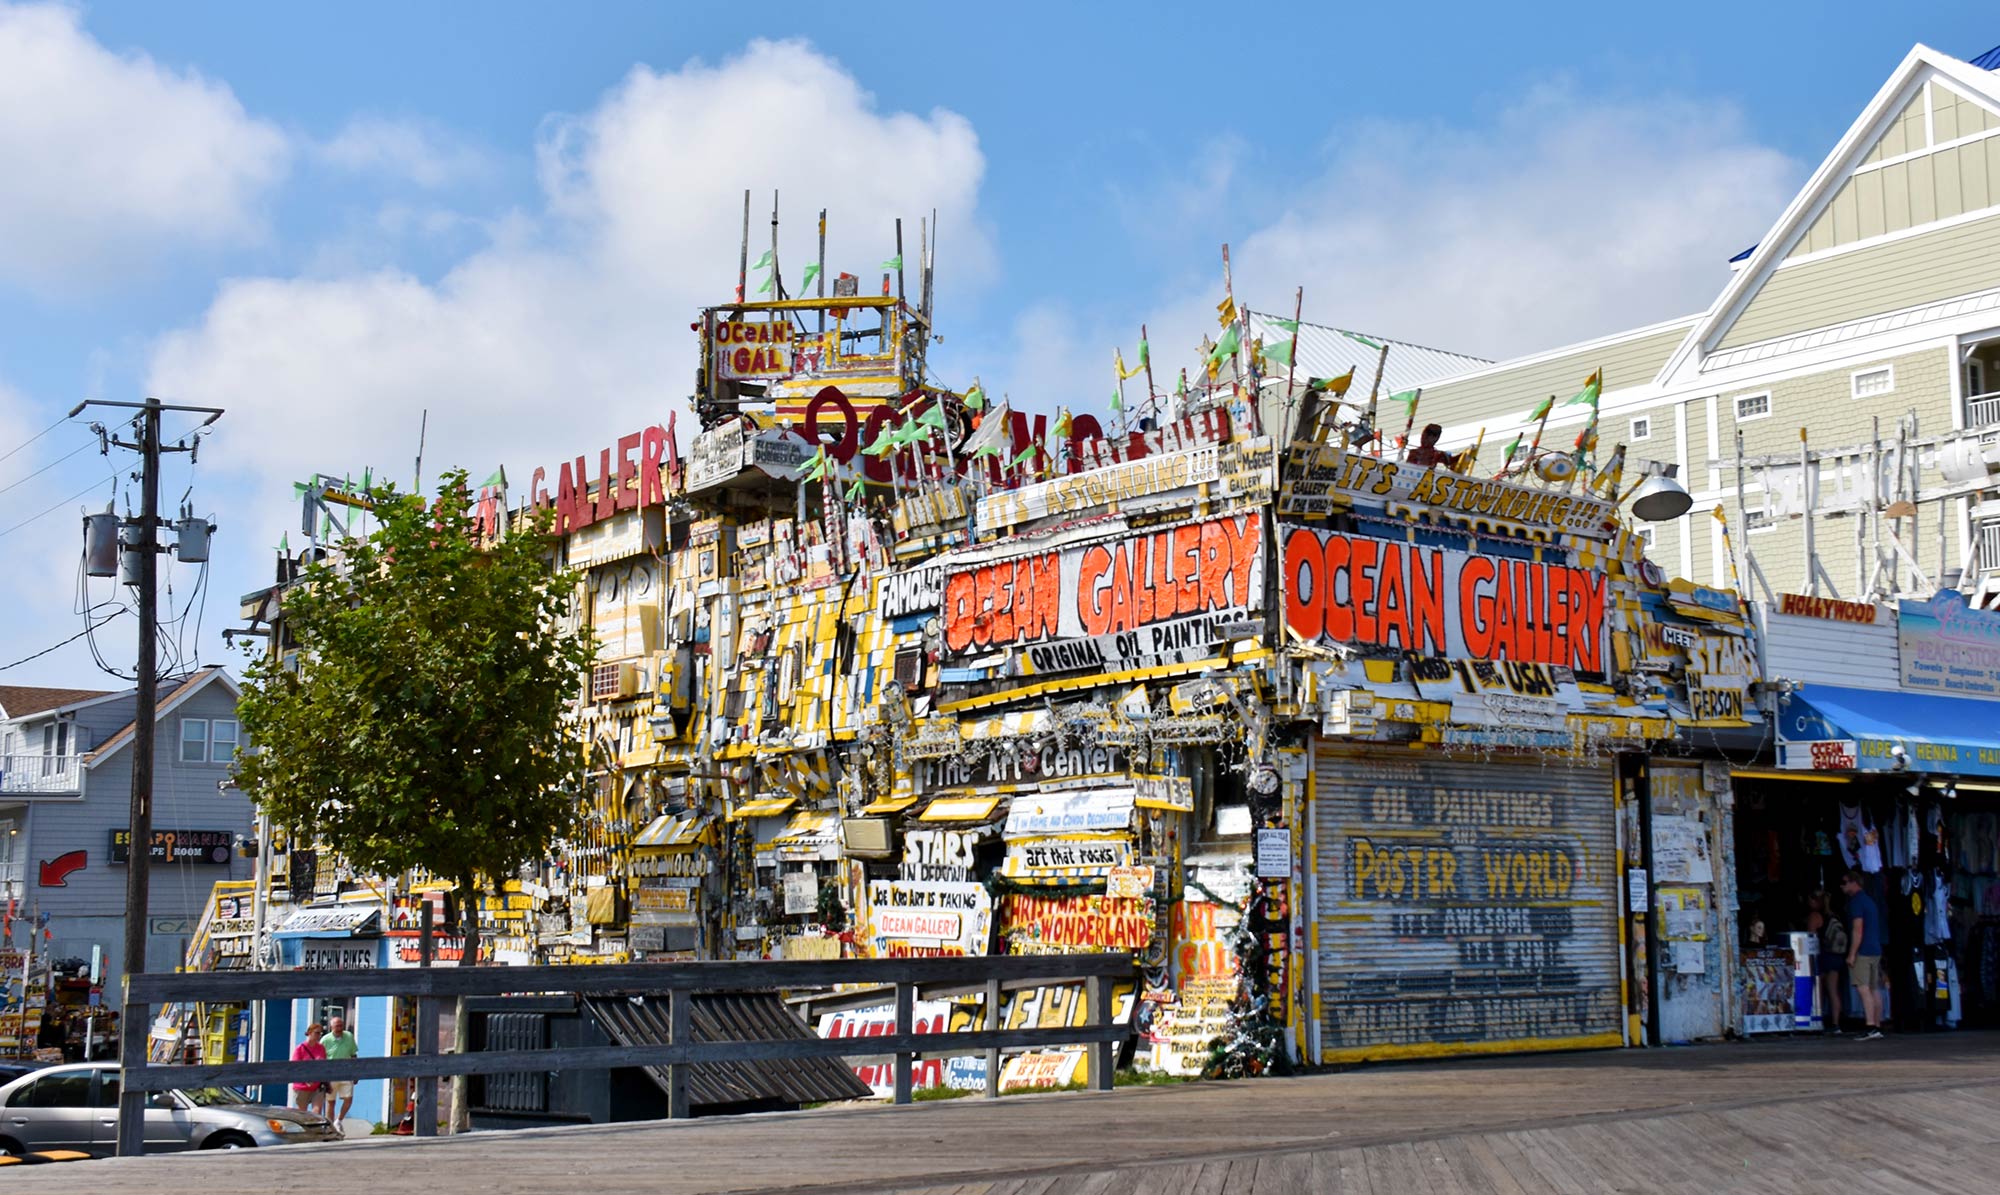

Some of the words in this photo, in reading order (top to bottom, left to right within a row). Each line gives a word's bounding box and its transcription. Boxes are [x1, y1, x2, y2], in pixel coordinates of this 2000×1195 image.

[530, 410, 681, 537] GALLERY
[1292, 481, 1330, 496] GALLERY
[1336, 453, 1399, 495] IT'S
[944, 551, 1060, 654] OCEAN
[1077, 511, 1261, 637] GALLERY
[1284, 528, 1447, 654] OCEAN
[1459, 555, 1607, 674] GALLERY
[1783, 593, 1877, 624] HOLLYWOOD
[1031, 638, 1106, 671] ORIGINAL
[1116, 631, 1143, 658] OIL
[1691, 689, 1743, 720] PERSON
[987, 750, 1022, 781] Art
[1040, 746, 1120, 778] Center
[1810, 741, 1845, 756] OCEAN
[1812, 754, 1856, 770] GALLERY
[1859, 740, 1893, 759] VAPE
[1916, 744, 1958, 762] HENNA
[1372, 785, 1414, 822] OIL
[1433, 786, 1553, 827] PAINTINGS
[173, 847, 203, 857] ROOM
[905, 830, 979, 870] STARS
[1026, 848, 1048, 867] art
[1050, 846, 1075, 865] that
[1353, 840, 1459, 900] POSTER
[1482, 850, 1572, 899] WORLD
[940, 892, 977, 910] TAKING
[881, 915, 912, 933] OCEAN
[914, 917, 957, 937] GALLERY
[1041, 914, 1150, 948] WONDERLAND
[1172, 901, 1223, 941] ART
[1444, 907, 1532, 935] AWESOME
[875, 936, 887, 951] TO
[305, 949, 341, 970] BEACHIN
[343, 949, 371, 970] BIKES
[1039, 1064, 1061, 1076] LIVE
